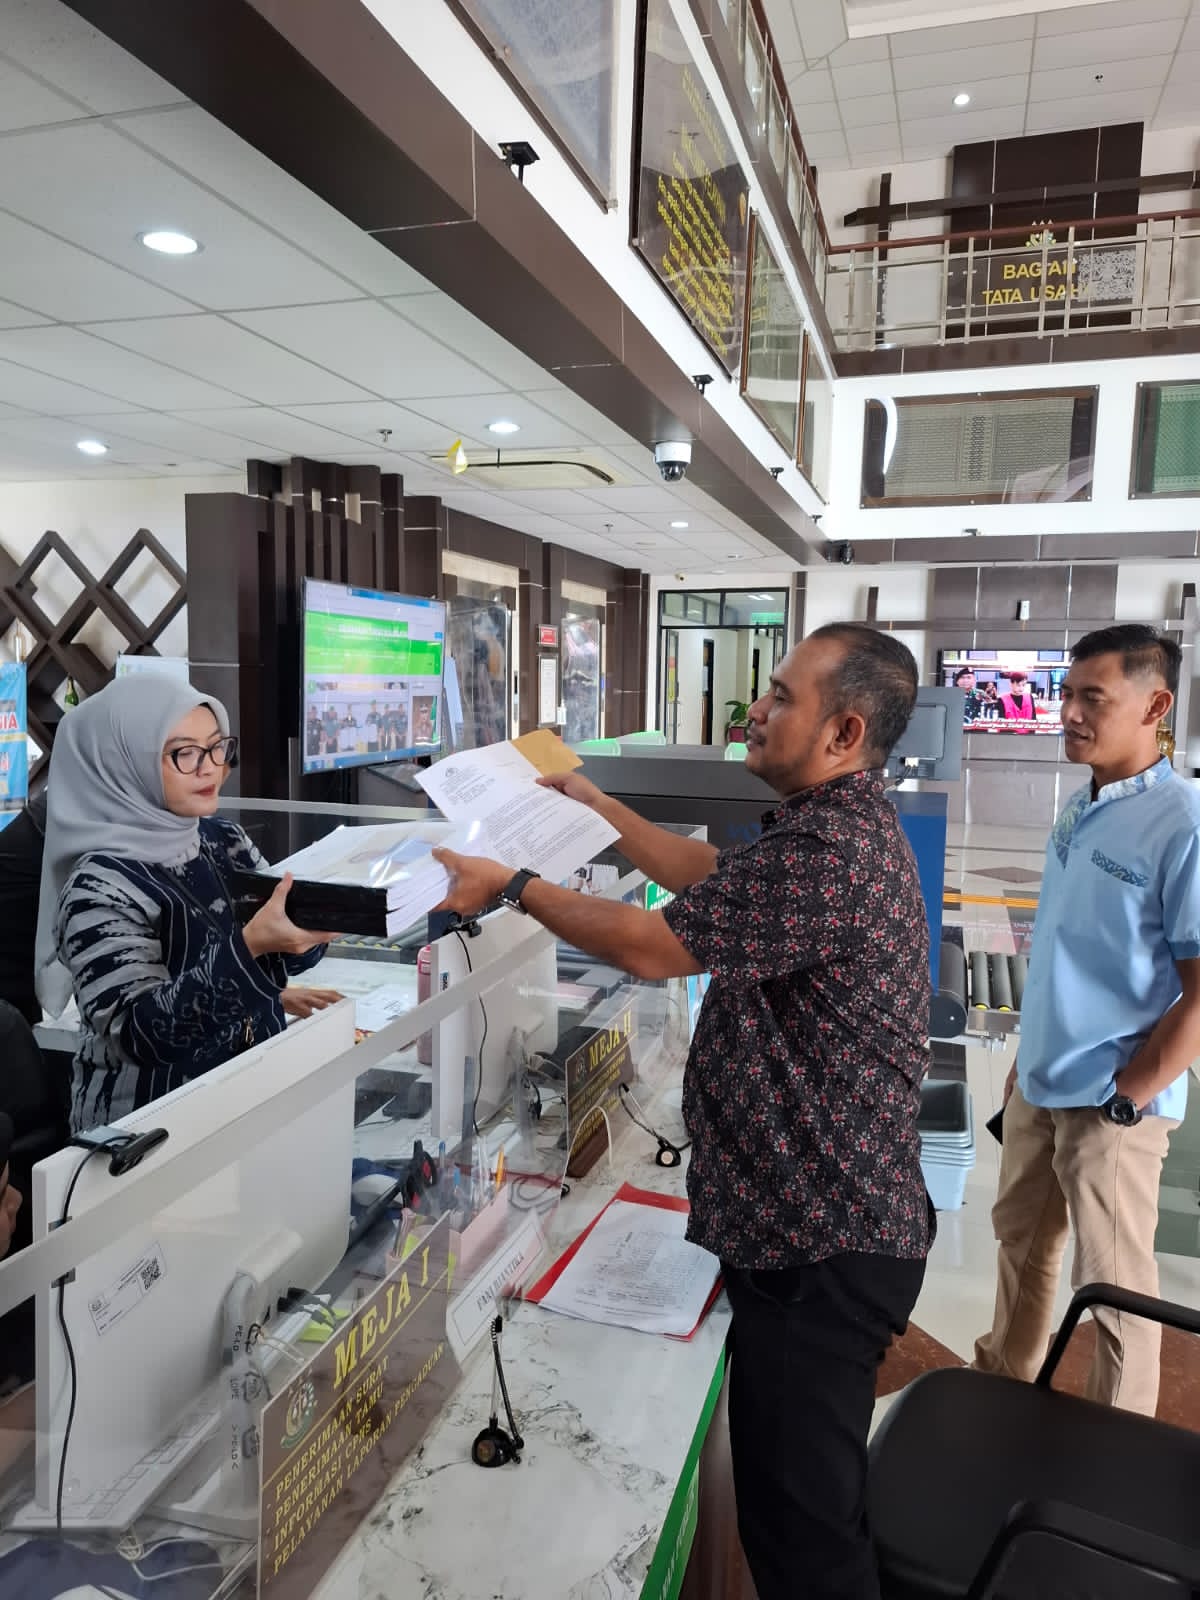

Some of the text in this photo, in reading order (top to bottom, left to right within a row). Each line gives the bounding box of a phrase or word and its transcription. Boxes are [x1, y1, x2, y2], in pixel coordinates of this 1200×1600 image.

[982, 287, 1024, 305] TATA
[1003, 259, 1076, 280] BAGAN
[588, 1007, 633, 1073] MEJA II
[332, 1246, 430, 1391] MEJA I
[273, 1341, 445, 1577] PELAYANAN LAPORAN PENGADUAN
[273, 1418, 372, 1553] INFORMASI CPNS
[274, 1381, 384, 1528] PENERIMAAN TAMU
[275, 1354, 389, 1501] PENERIMAAN SURAT
